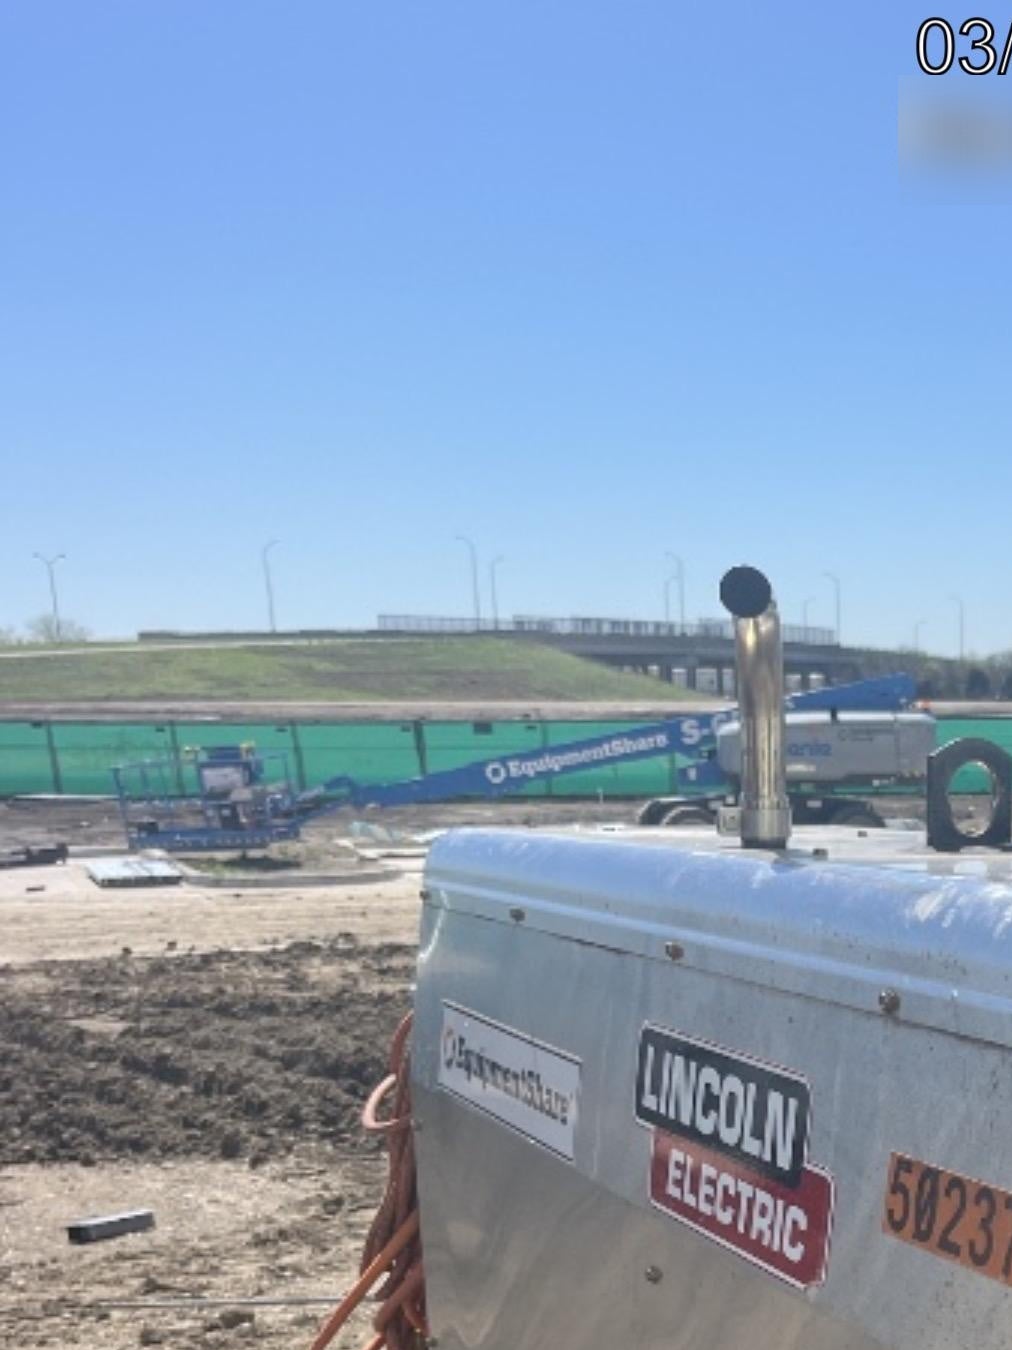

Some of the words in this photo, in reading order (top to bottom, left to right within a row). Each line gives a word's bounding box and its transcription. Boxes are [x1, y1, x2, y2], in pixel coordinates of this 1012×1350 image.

[506, 732, 668, 779] EquipmentShare
[457, 1035, 570, 1127] EquipmentShare
[641, 1045, 798, 1171] LINCOLN
[665, 1148, 808, 1264] ELECTRIC
